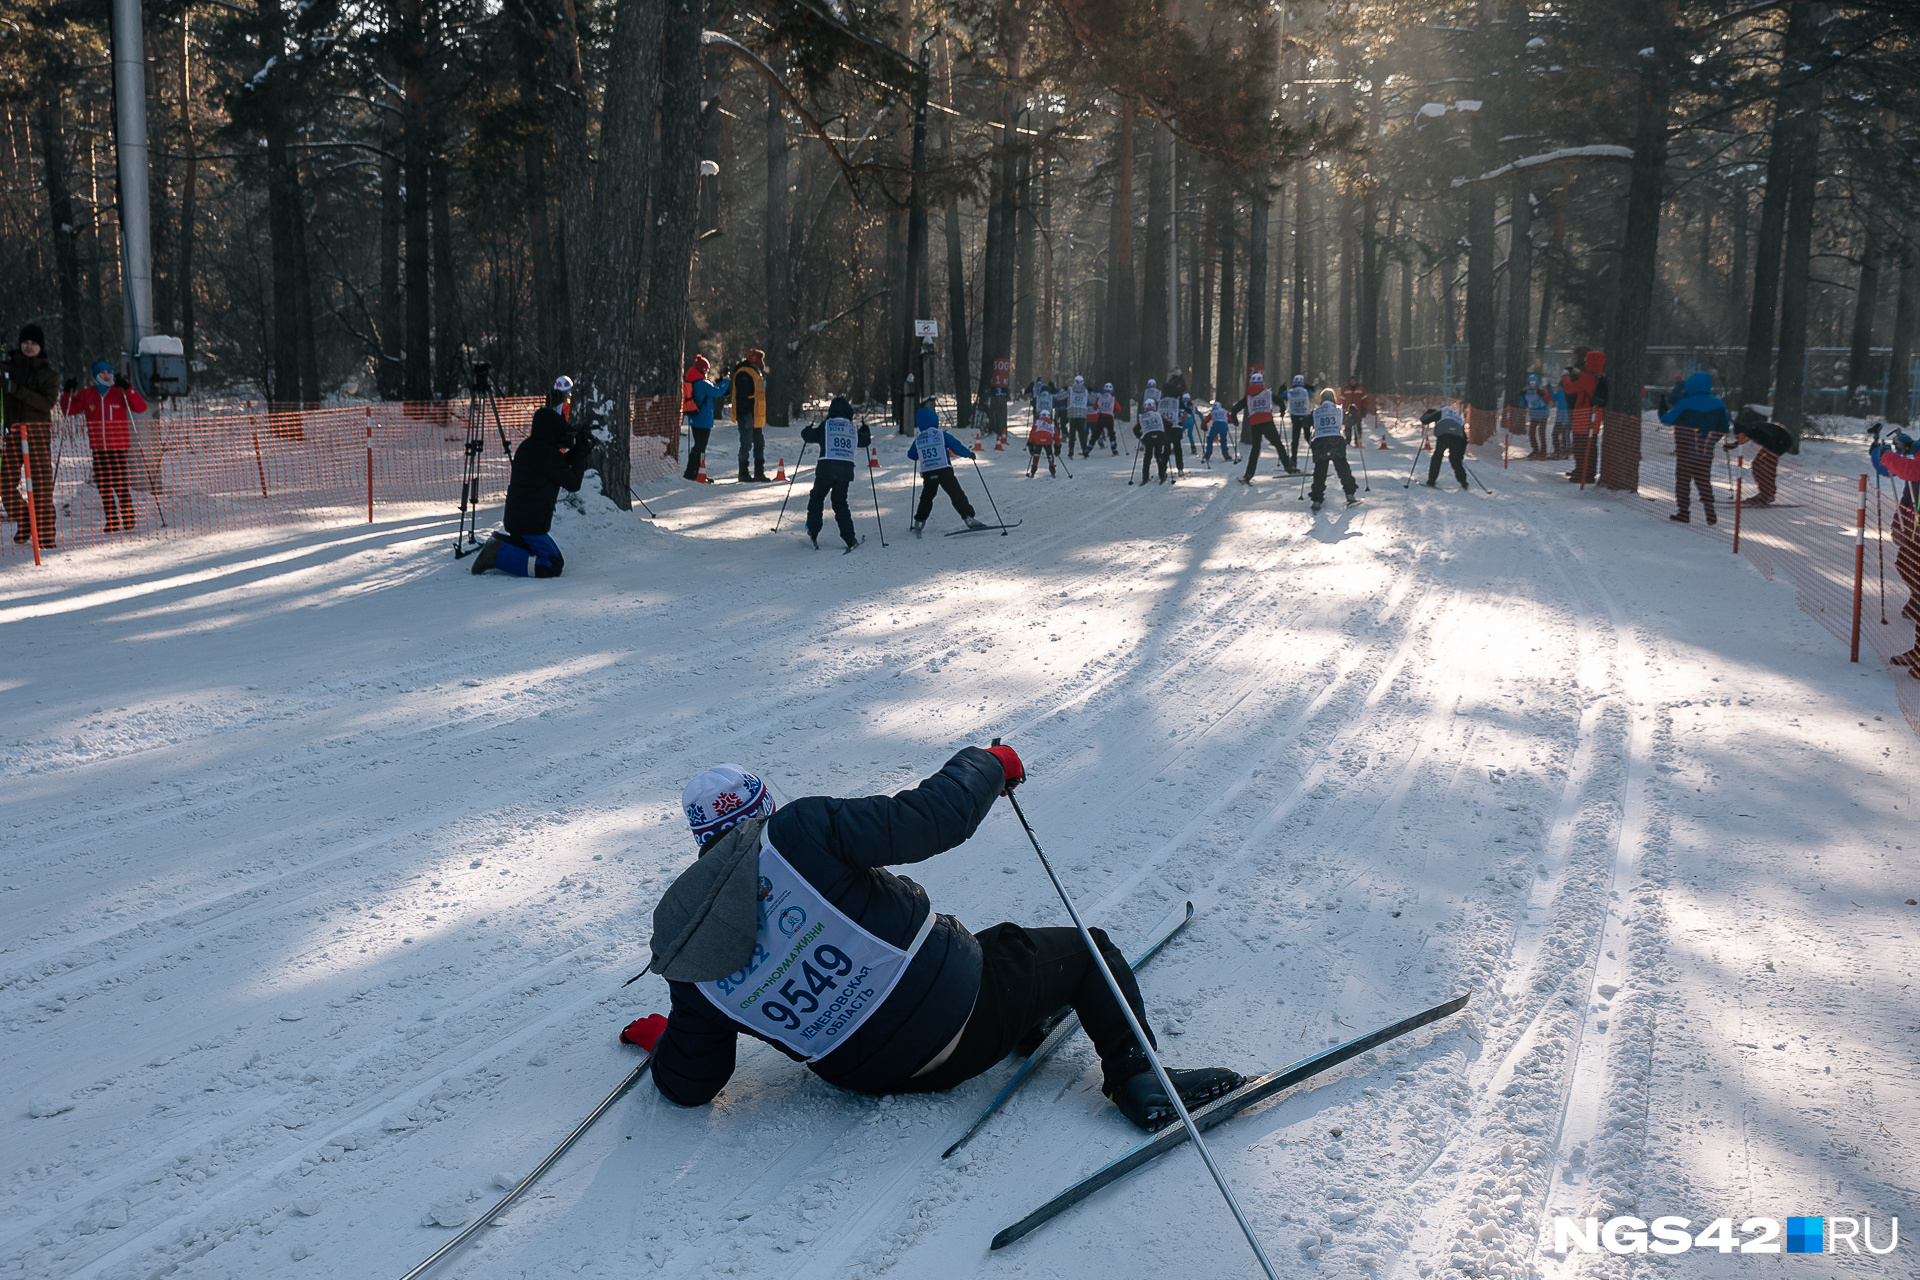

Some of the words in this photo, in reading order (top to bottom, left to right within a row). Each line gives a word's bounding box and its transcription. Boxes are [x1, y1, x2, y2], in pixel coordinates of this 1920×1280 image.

[996, 375, 1001, 385] 1
[1319, 416, 1336, 427] 893
[833, 437, 852, 449] 898
[921, 447, 938, 459] 853
[740, 986, 766, 1009] СПОРТ
[765, 952, 798, 986] НОРМА
[792, 921, 826, 955] ЖИЗНИ
[761, 943, 853, 1031] 9549
[800, 965, 873, 1041] КЕМЕРОВСКАЯ
[825, 987, 875, 1036] ОБЛАСТЬ
